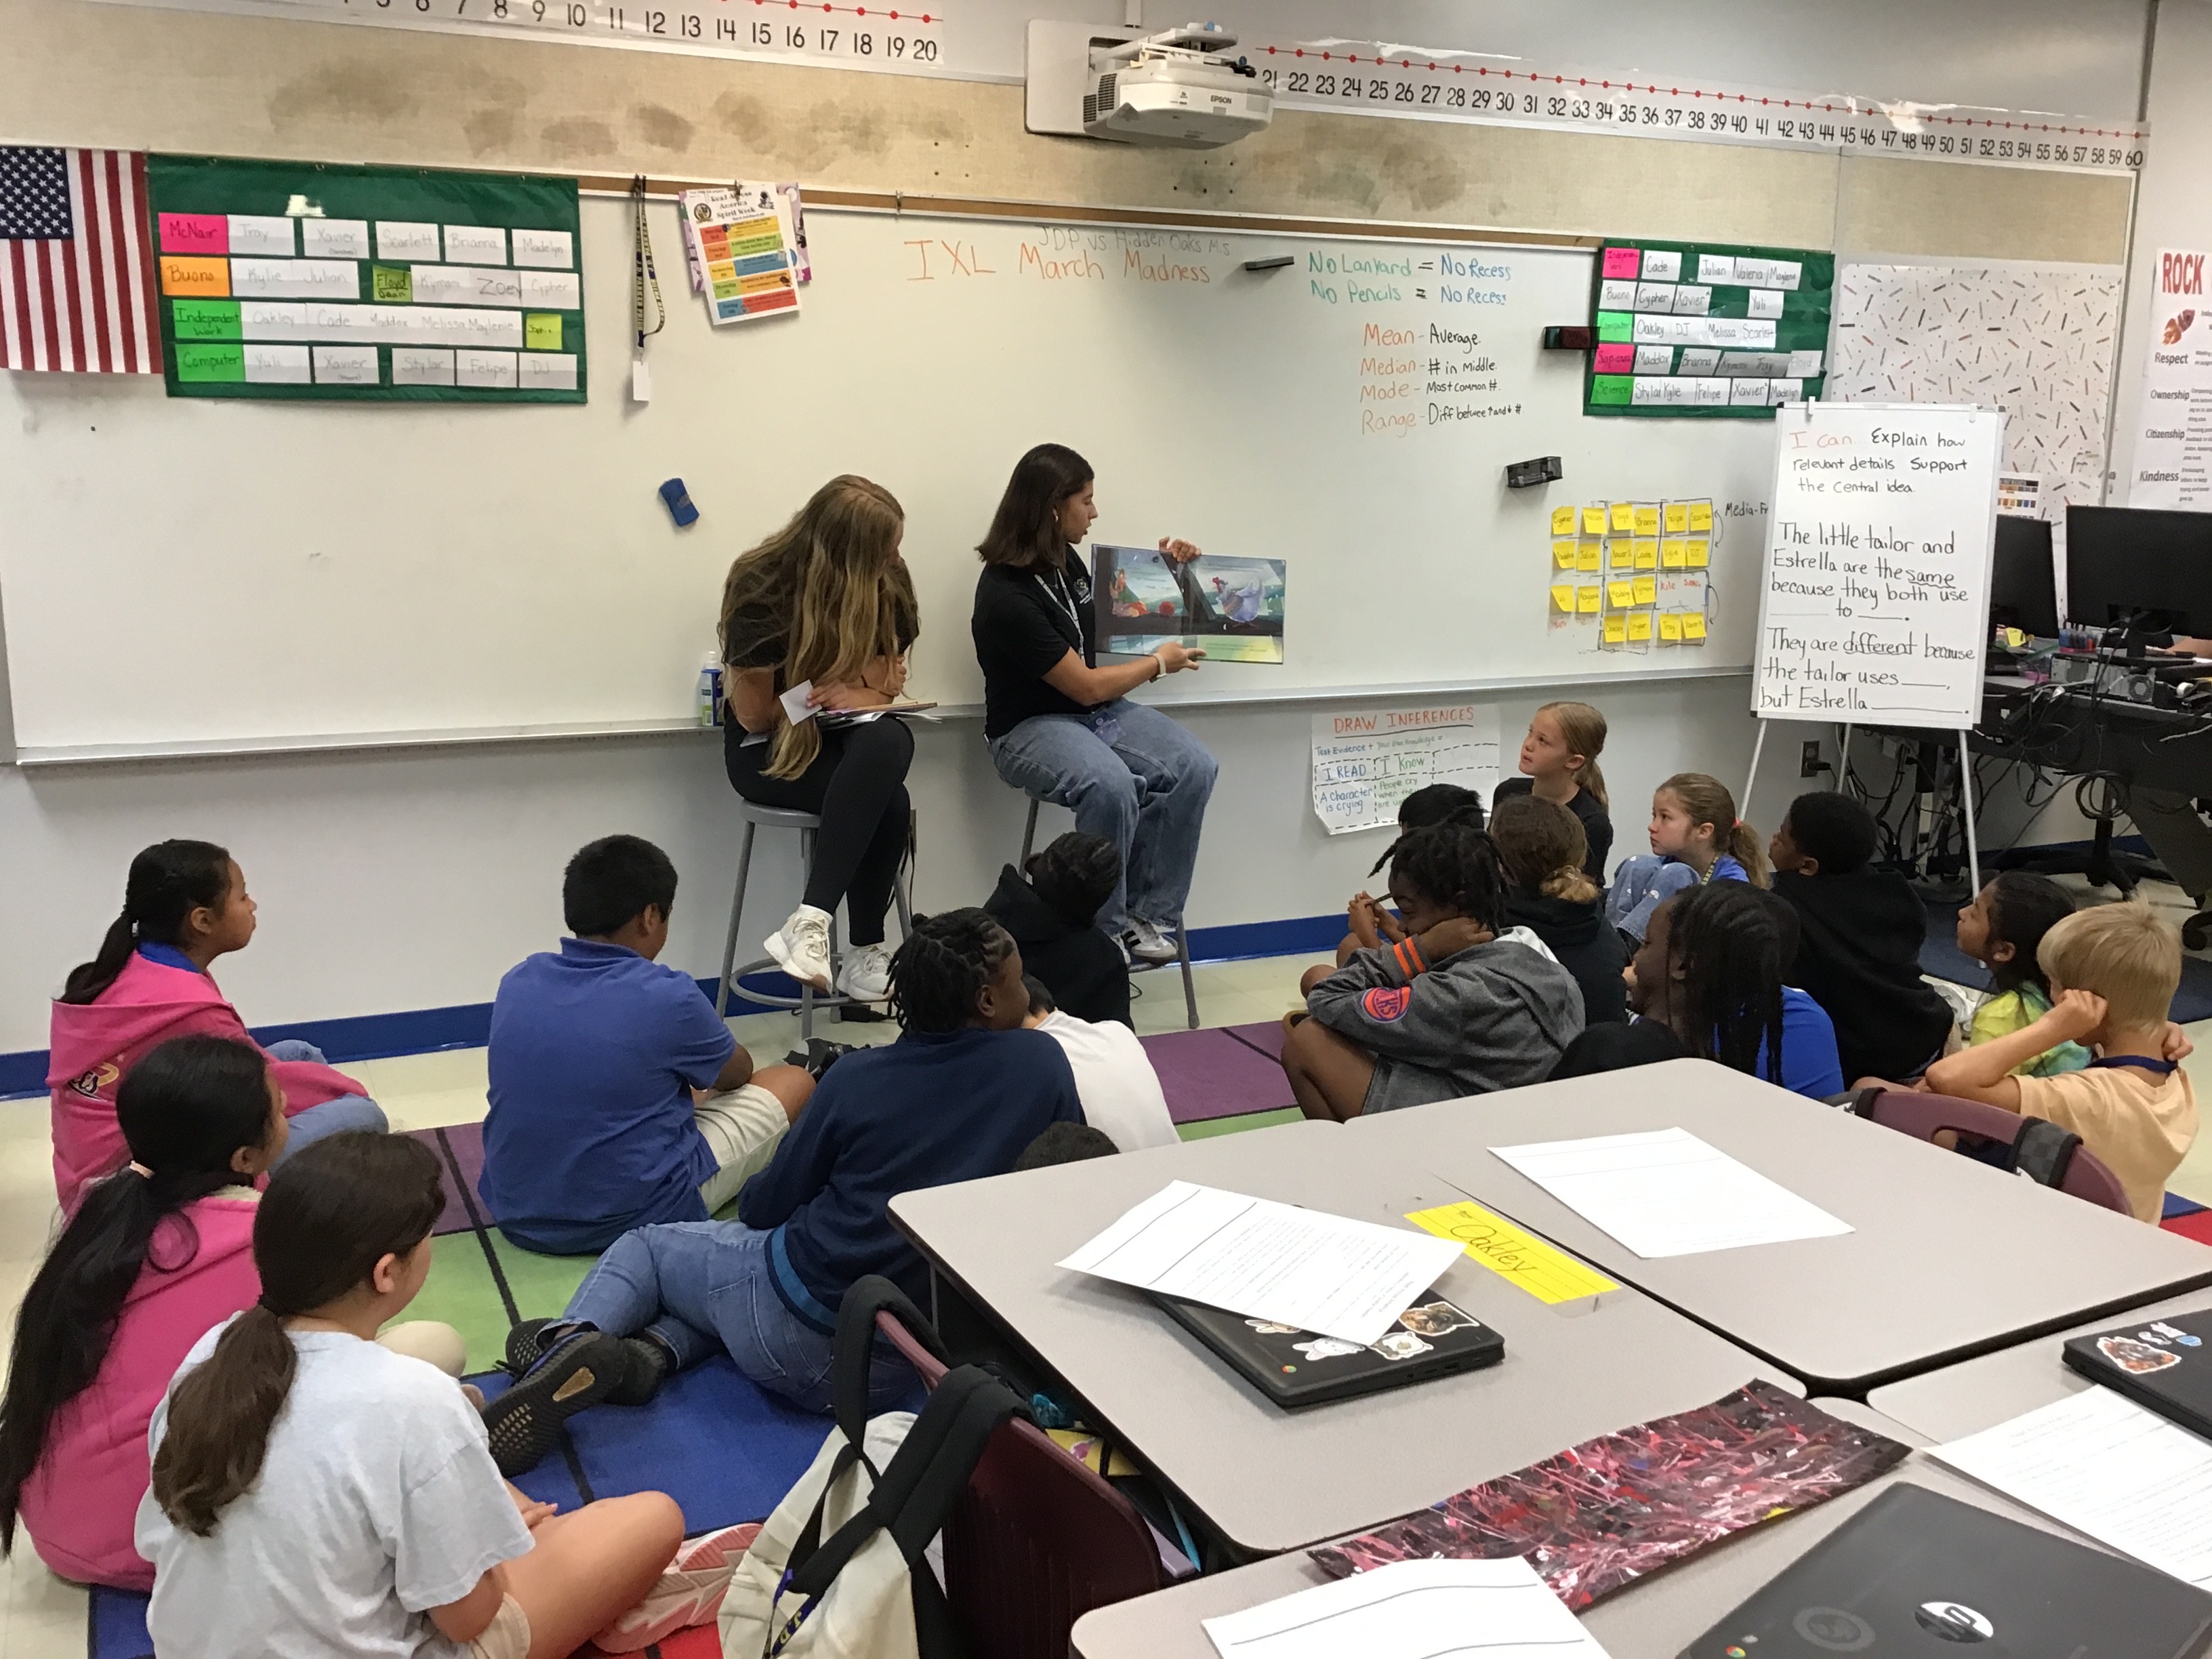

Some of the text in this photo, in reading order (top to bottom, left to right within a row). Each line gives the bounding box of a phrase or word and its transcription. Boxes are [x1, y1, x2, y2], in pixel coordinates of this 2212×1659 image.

[493, 0, 937, 61] 8 9 10 11 12 13 14 15 16 17 18 19 20
[1210, 95, 1232, 104] EPSON
[1288, 72, 1538, 113] 22 23 24 25 26 27 28 29 30 31
[1034, 224, 1080, 252] JDP
[1115, 228, 1164, 250] Hidden
[1169, 235, 1202, 253] Oaks
[904, 239, 1210, 284] IXL March Madness
[1309, 250, 1336, 274] No
[1441, 252, 1466, 276] No
[1469, 258, 1511, 281] Recess
[2161, 253, 2205, 295] ROCK
[1311, 279, 1338, 304] No
[1347, 279, 1401, 304] Pencils
[1441, 285, 1462, 304] No
[1639, 288, 1668, 308] Cypher
[1637, 319, 1664, 338] Oakley
[1676, 322, 1691, 336] DJ
[1708, 323, 1736, 338] Melissa
[1428, 358, 1441, 375] #
[1446, 361, 1458, 375] in
[2154, 352, 2189, 366] Respect
[2150, 388, 2190, 401] Ownership
[1429, 402, 1454, 425] Diff
[1788, 430, 1807, 450] I
[1871, 428, 1927, 449] Explain
[1938, 432, 1966, 448] how
[2145, 428, 2186, 442] Citizenship
[1793, 457, 1845, 471] relevant
[1849, 456, 1895, 471] details
[1798, 477, 1825, 493] the
[2139, 470, 2180, 483] Kindness
[1778, 521, 1955, 555] The little tailor and
[1773, 548, 1955, 588] Estrella are the same
[1771, 572, 1969, 611] because they both use
[1835, 597, 1853, 618] to
[1766, 626, 1976, 661] They are different because
[1763, 656, 1900, 685] the tailor uses
[1759, 684, 1868, 710] but Estrella
[1334, 706, 1475, 734] DRAW INFERENCES
[1333, 745, 1366, 755] Evidence
[1322, 764, 1367, 782] I READ
[1380, 758, 1391, 775] I
[1319, 791, 1328, 804] A
[1378, 791, 1398, 799] when
[1326, 799, 1364, 817] is crying
[1450, 1224, 1537, 1272] Oakley
